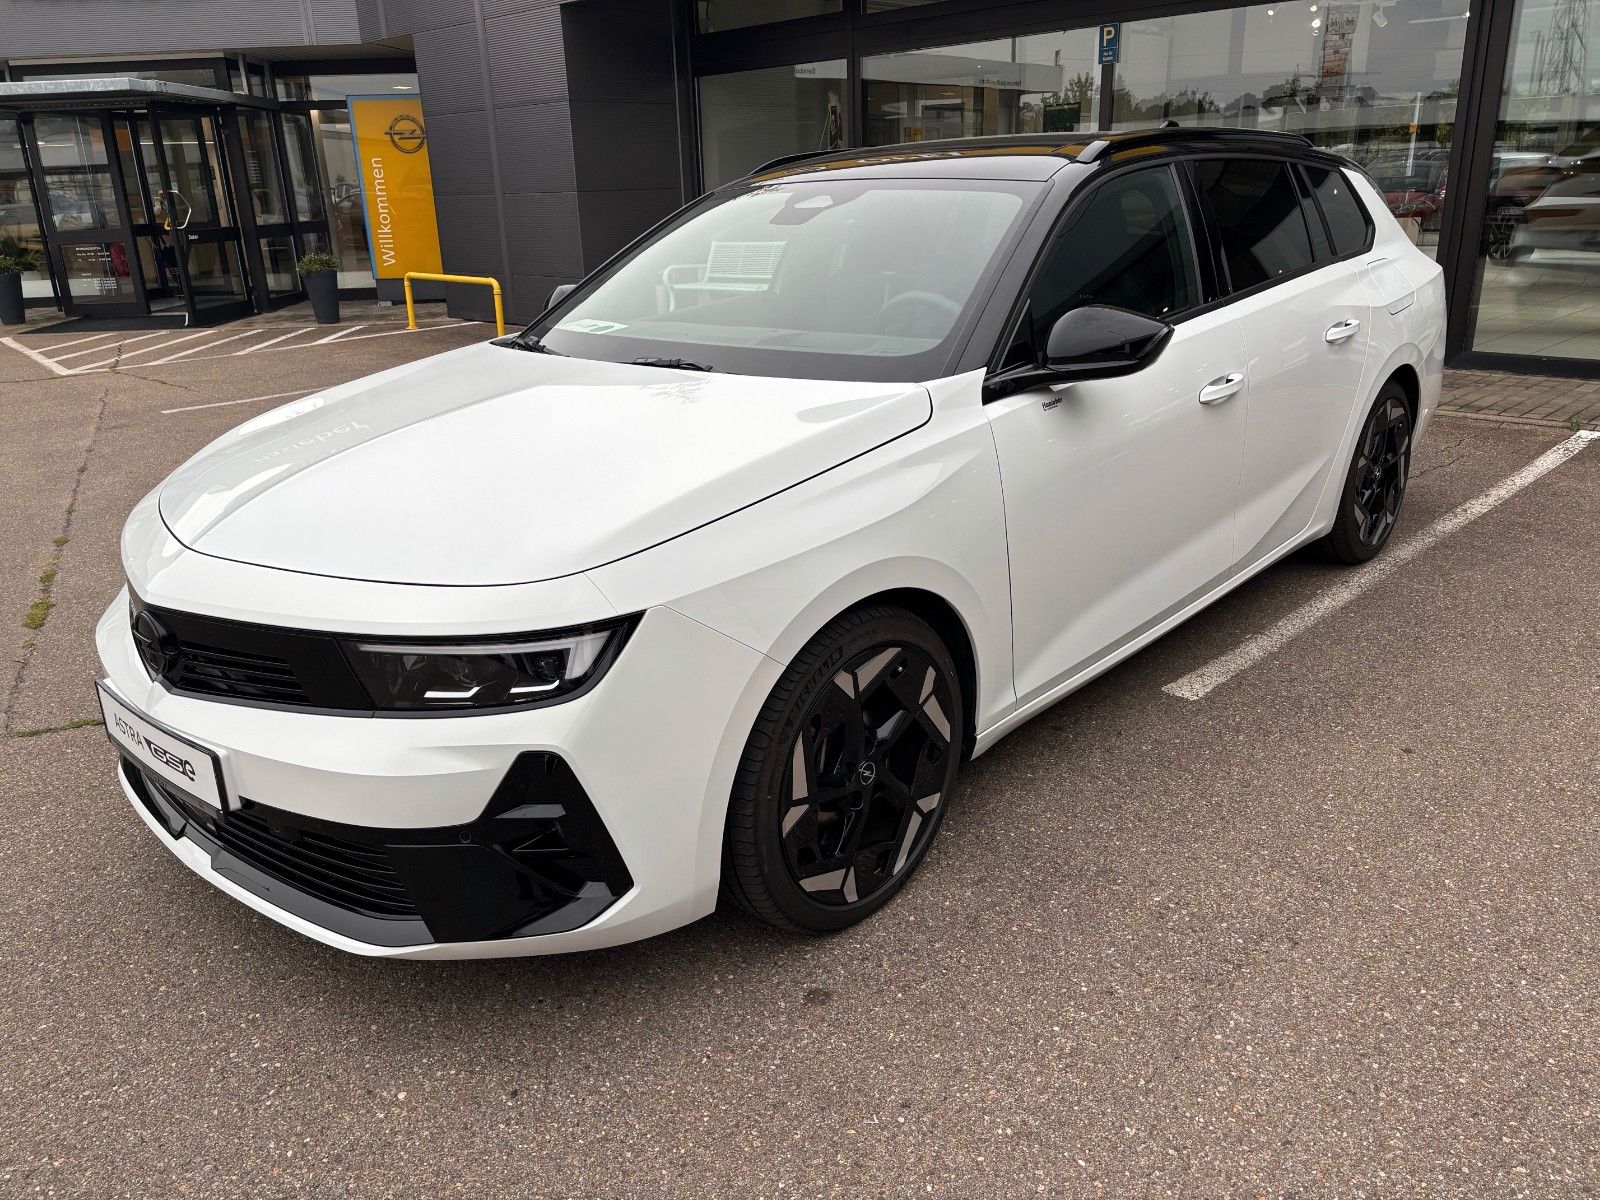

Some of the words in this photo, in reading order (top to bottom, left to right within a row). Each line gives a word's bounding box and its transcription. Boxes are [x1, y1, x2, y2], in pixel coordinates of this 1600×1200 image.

[1103, 26, 1115, 47] P
[371, 157, 397, 267] Willkommen
[113, 712, 145, 750] ASTRA
[142, 735, 196, 782] GSe
